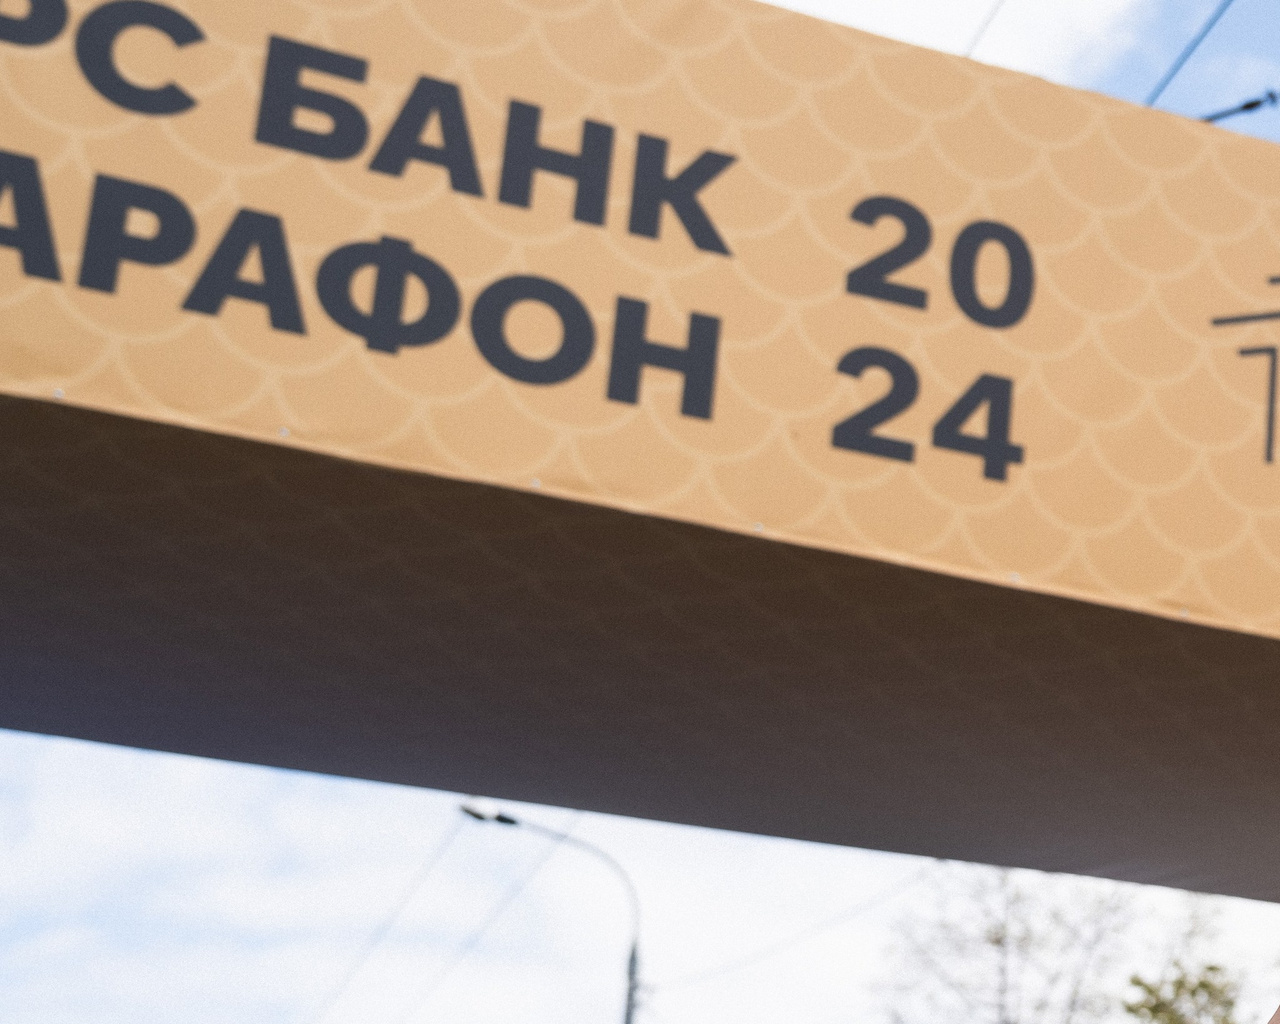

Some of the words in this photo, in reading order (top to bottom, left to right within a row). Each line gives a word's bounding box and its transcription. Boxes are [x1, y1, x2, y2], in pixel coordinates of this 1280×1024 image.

[254, 35, 740, 258] БАНК
[845, 195, 1036, 330] 20
[830, 345, 1025, 482] 24
